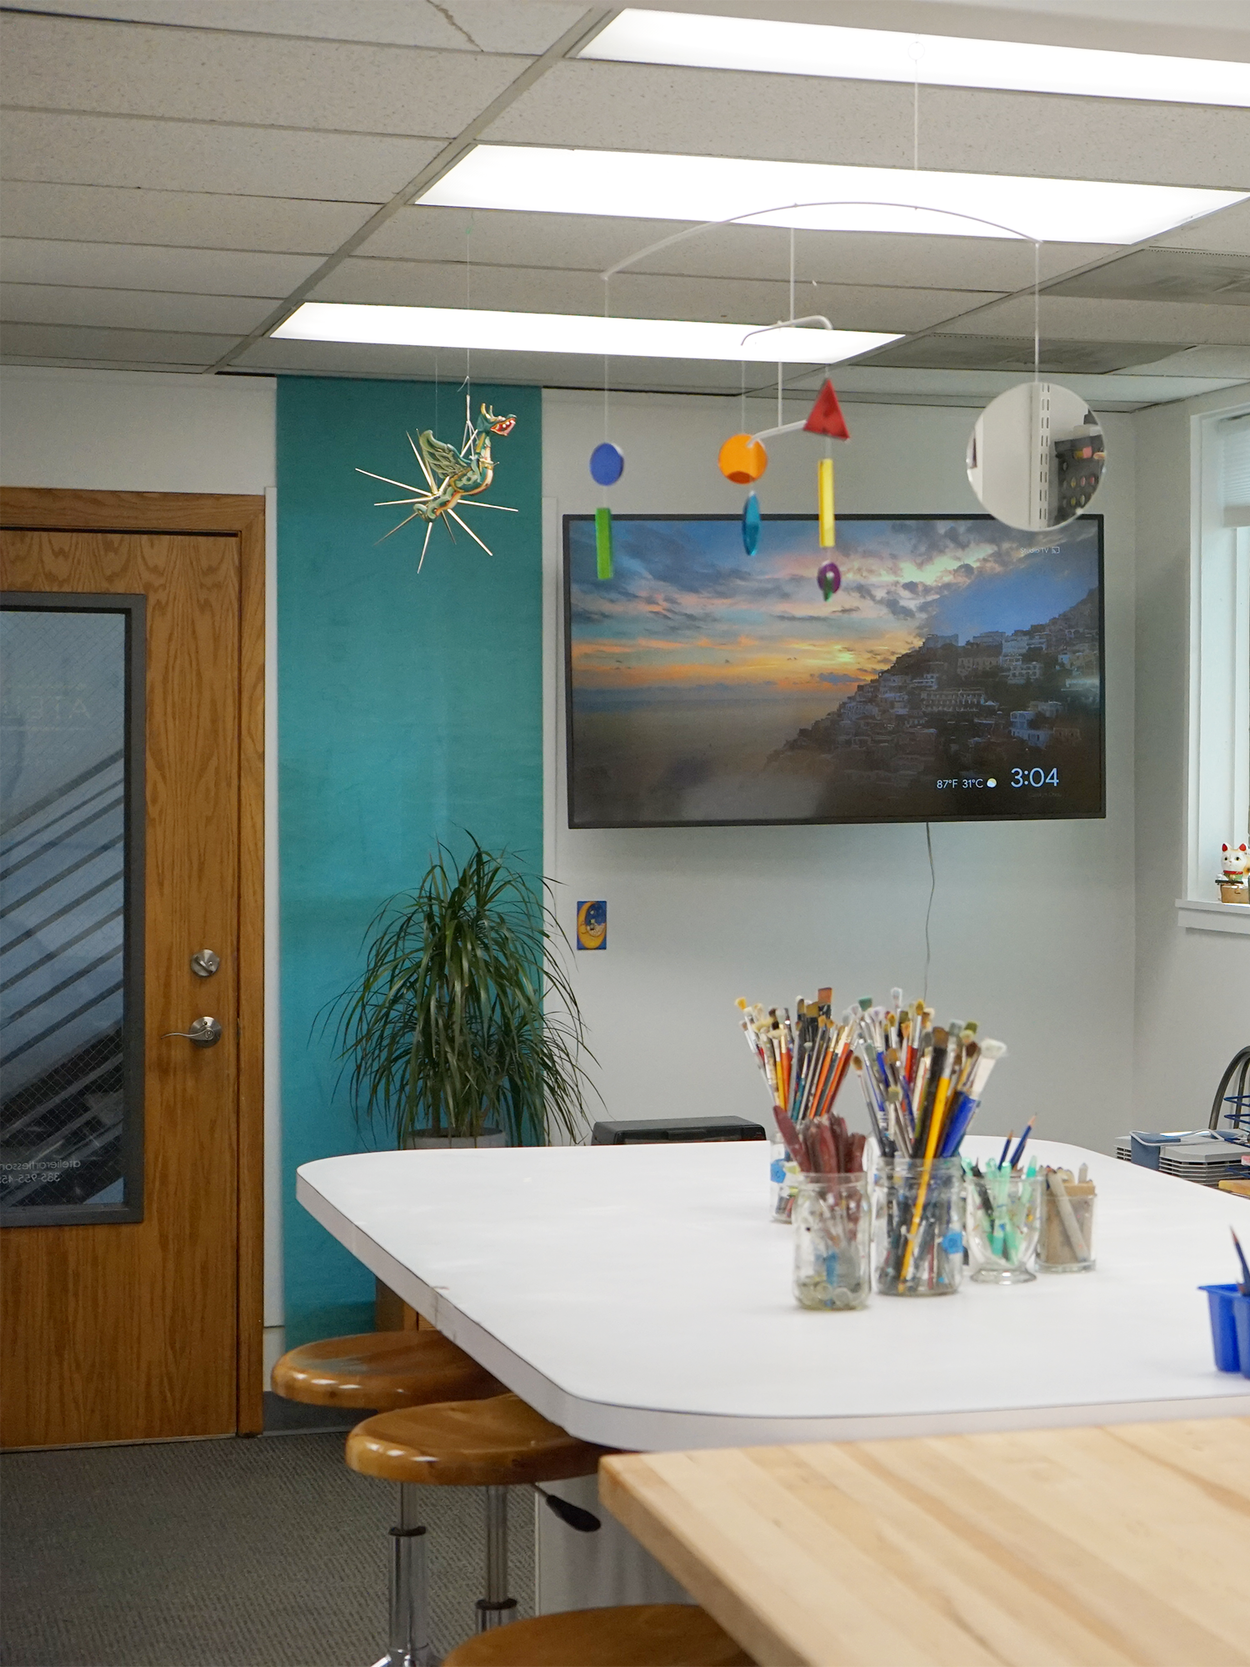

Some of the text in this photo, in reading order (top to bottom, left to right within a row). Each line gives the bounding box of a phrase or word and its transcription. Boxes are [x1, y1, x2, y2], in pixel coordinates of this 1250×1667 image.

[936, 778, 984, 789] 87°F 31°C
[1010, 767, 1060, 788] 3:04
